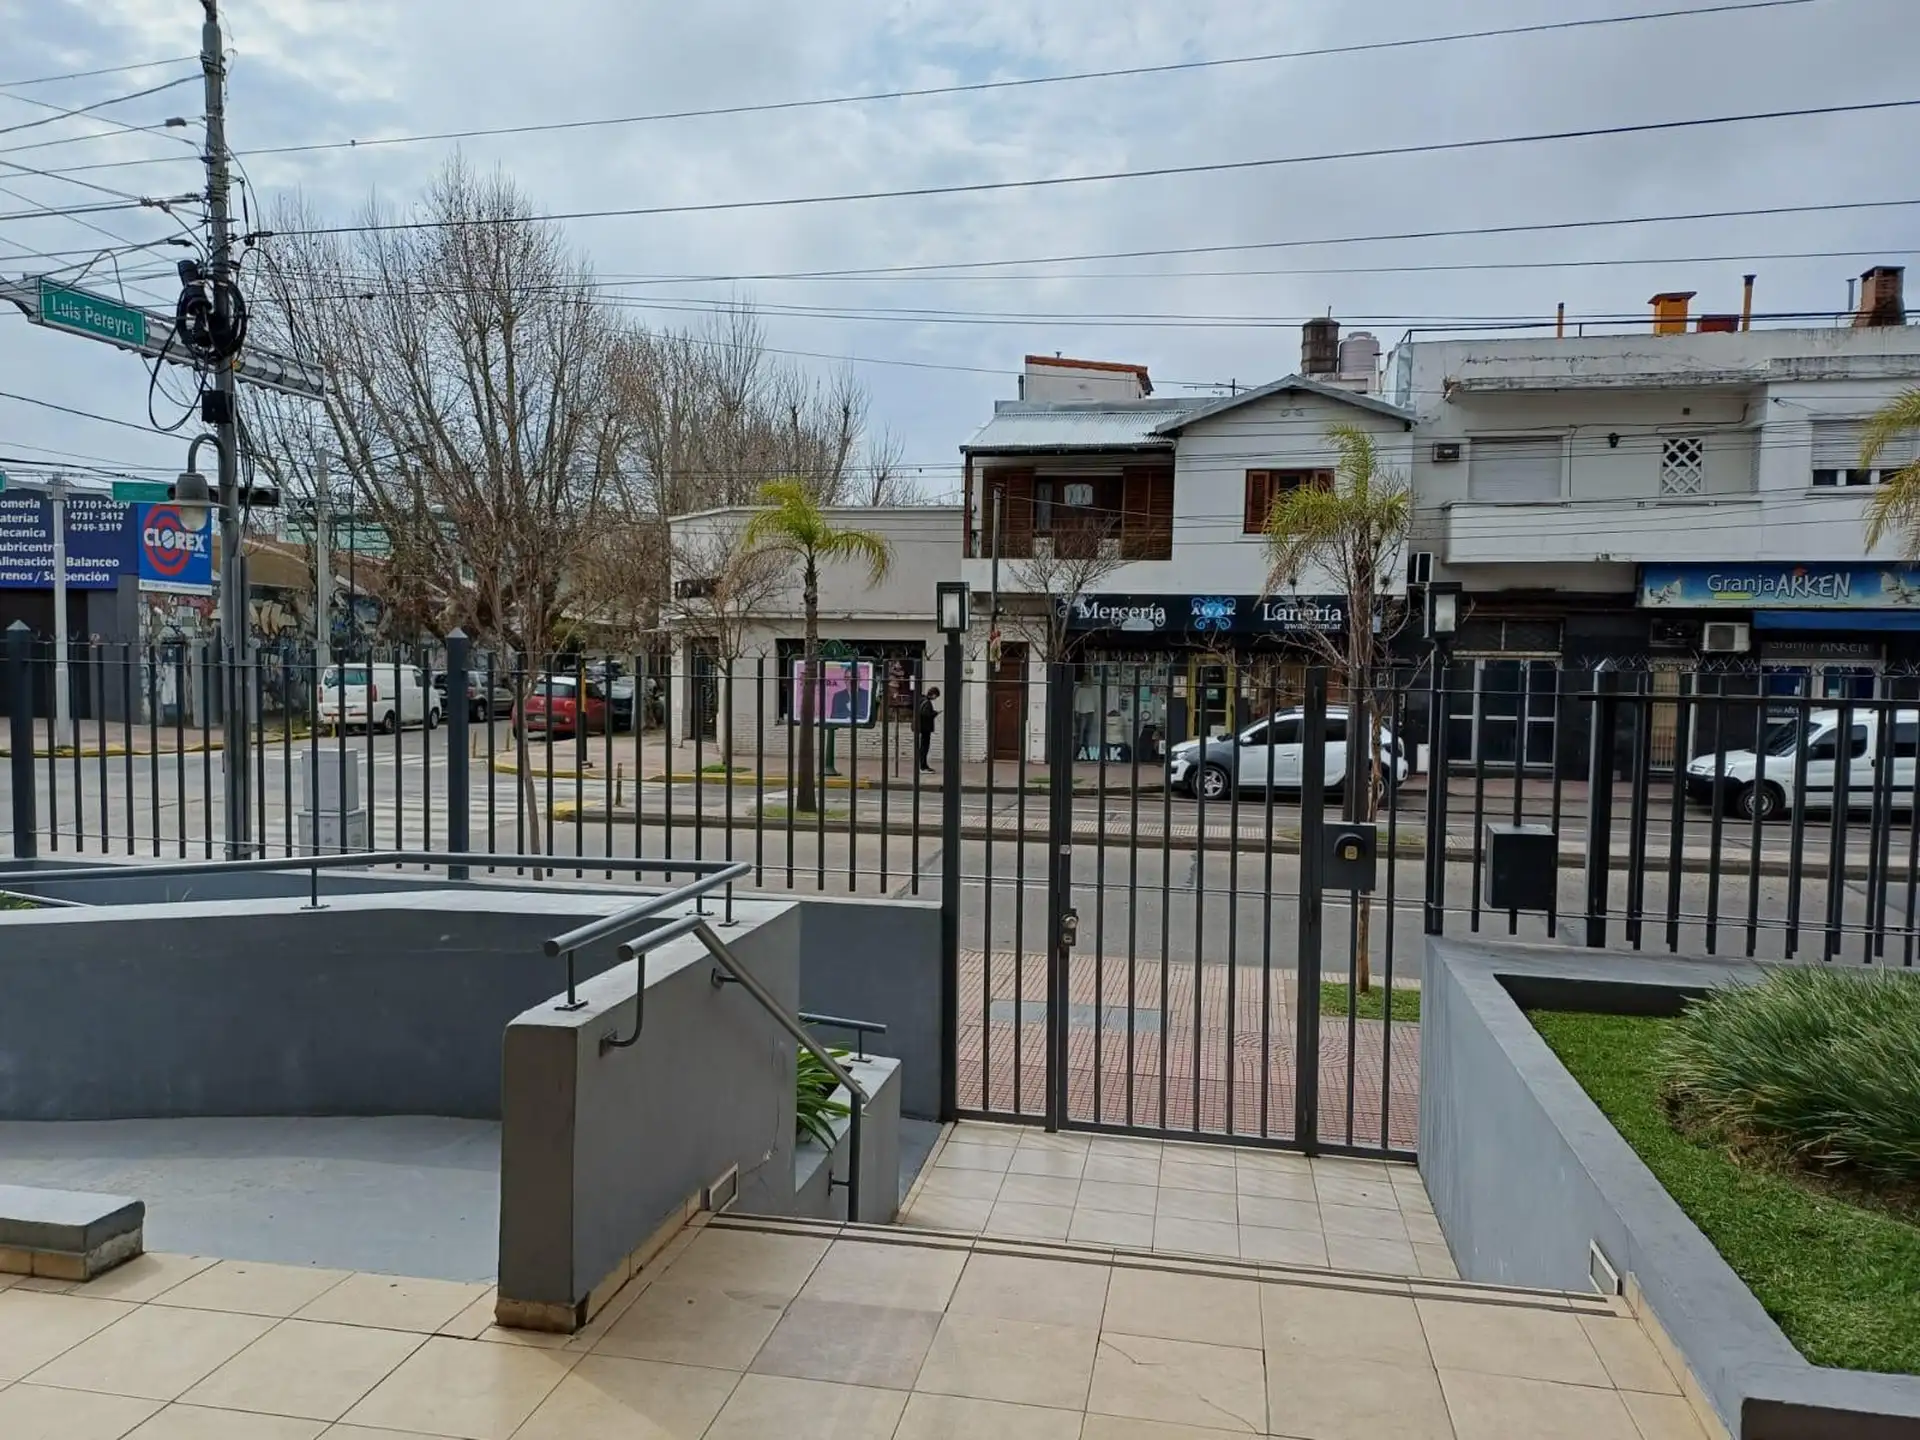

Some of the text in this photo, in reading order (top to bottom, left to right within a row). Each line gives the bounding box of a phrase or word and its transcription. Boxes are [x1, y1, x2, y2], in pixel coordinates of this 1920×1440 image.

[52, 295, 134, 336] Luis Pereyra
[0, 499, 40, 509] omeria
[0, 513, 39, 523] aterias
[0, 528, 46, 538] ecanica
[143, 527, 204, 553] CLOREX
[0, 542, 55, 552] ubricentr
[66, 557, 119, 567] Balanceo
[0, 572, 33, 581] renos
[1079, 602, 1166, 619] Mercería
[1263, 603, 1342, 621] Lanería
[1078, 746, 1122, 761] AWK
